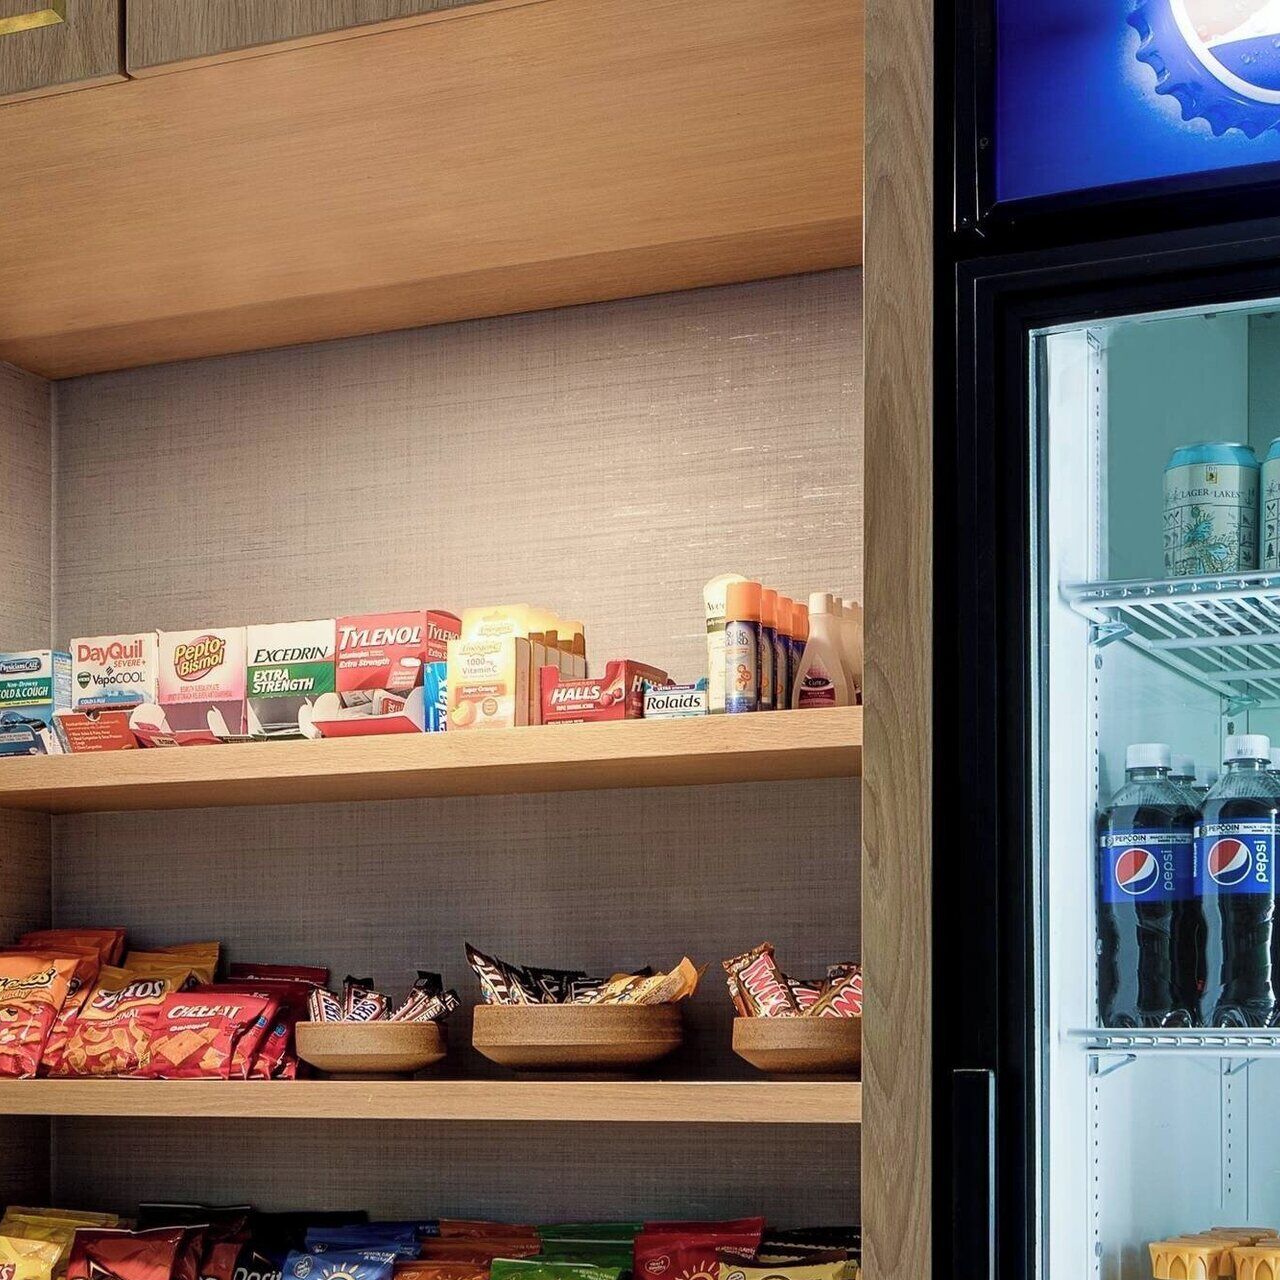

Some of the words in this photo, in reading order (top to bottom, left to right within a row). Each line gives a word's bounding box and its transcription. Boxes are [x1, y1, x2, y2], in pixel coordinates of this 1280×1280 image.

[1181, 489, 1209, 499] LAGER
[339, 626, 421, 651] TYLENOL
[78, 640, 144, 666] DayQuil
[174, 636, 226, 665] Pepto-
[254, 646, 328, 664] EXCEDRIN
[180, 650, 225, 676] Bismol
[466, 658, 485, 666] 1000
[93, 671, 145, 687] VapoCOOL
[253, 669, 289, 683] EXTRA
[462, 667, 490, 676] Vitamin
[22, 687, 48, 698] COUGH
[253, 678, 314, 694] STRENGTH
[551, 685, 601, 704] HALLS
[646, 695, 701, 710] Rolaids
[1209, 824, 1240, 833] PEPCOIN
[1115, 834, 1147, 843] PEPCOIN
[1254, 840, 1269, 883] pepsi
[1161, 850, 1176, 891] pepsi
